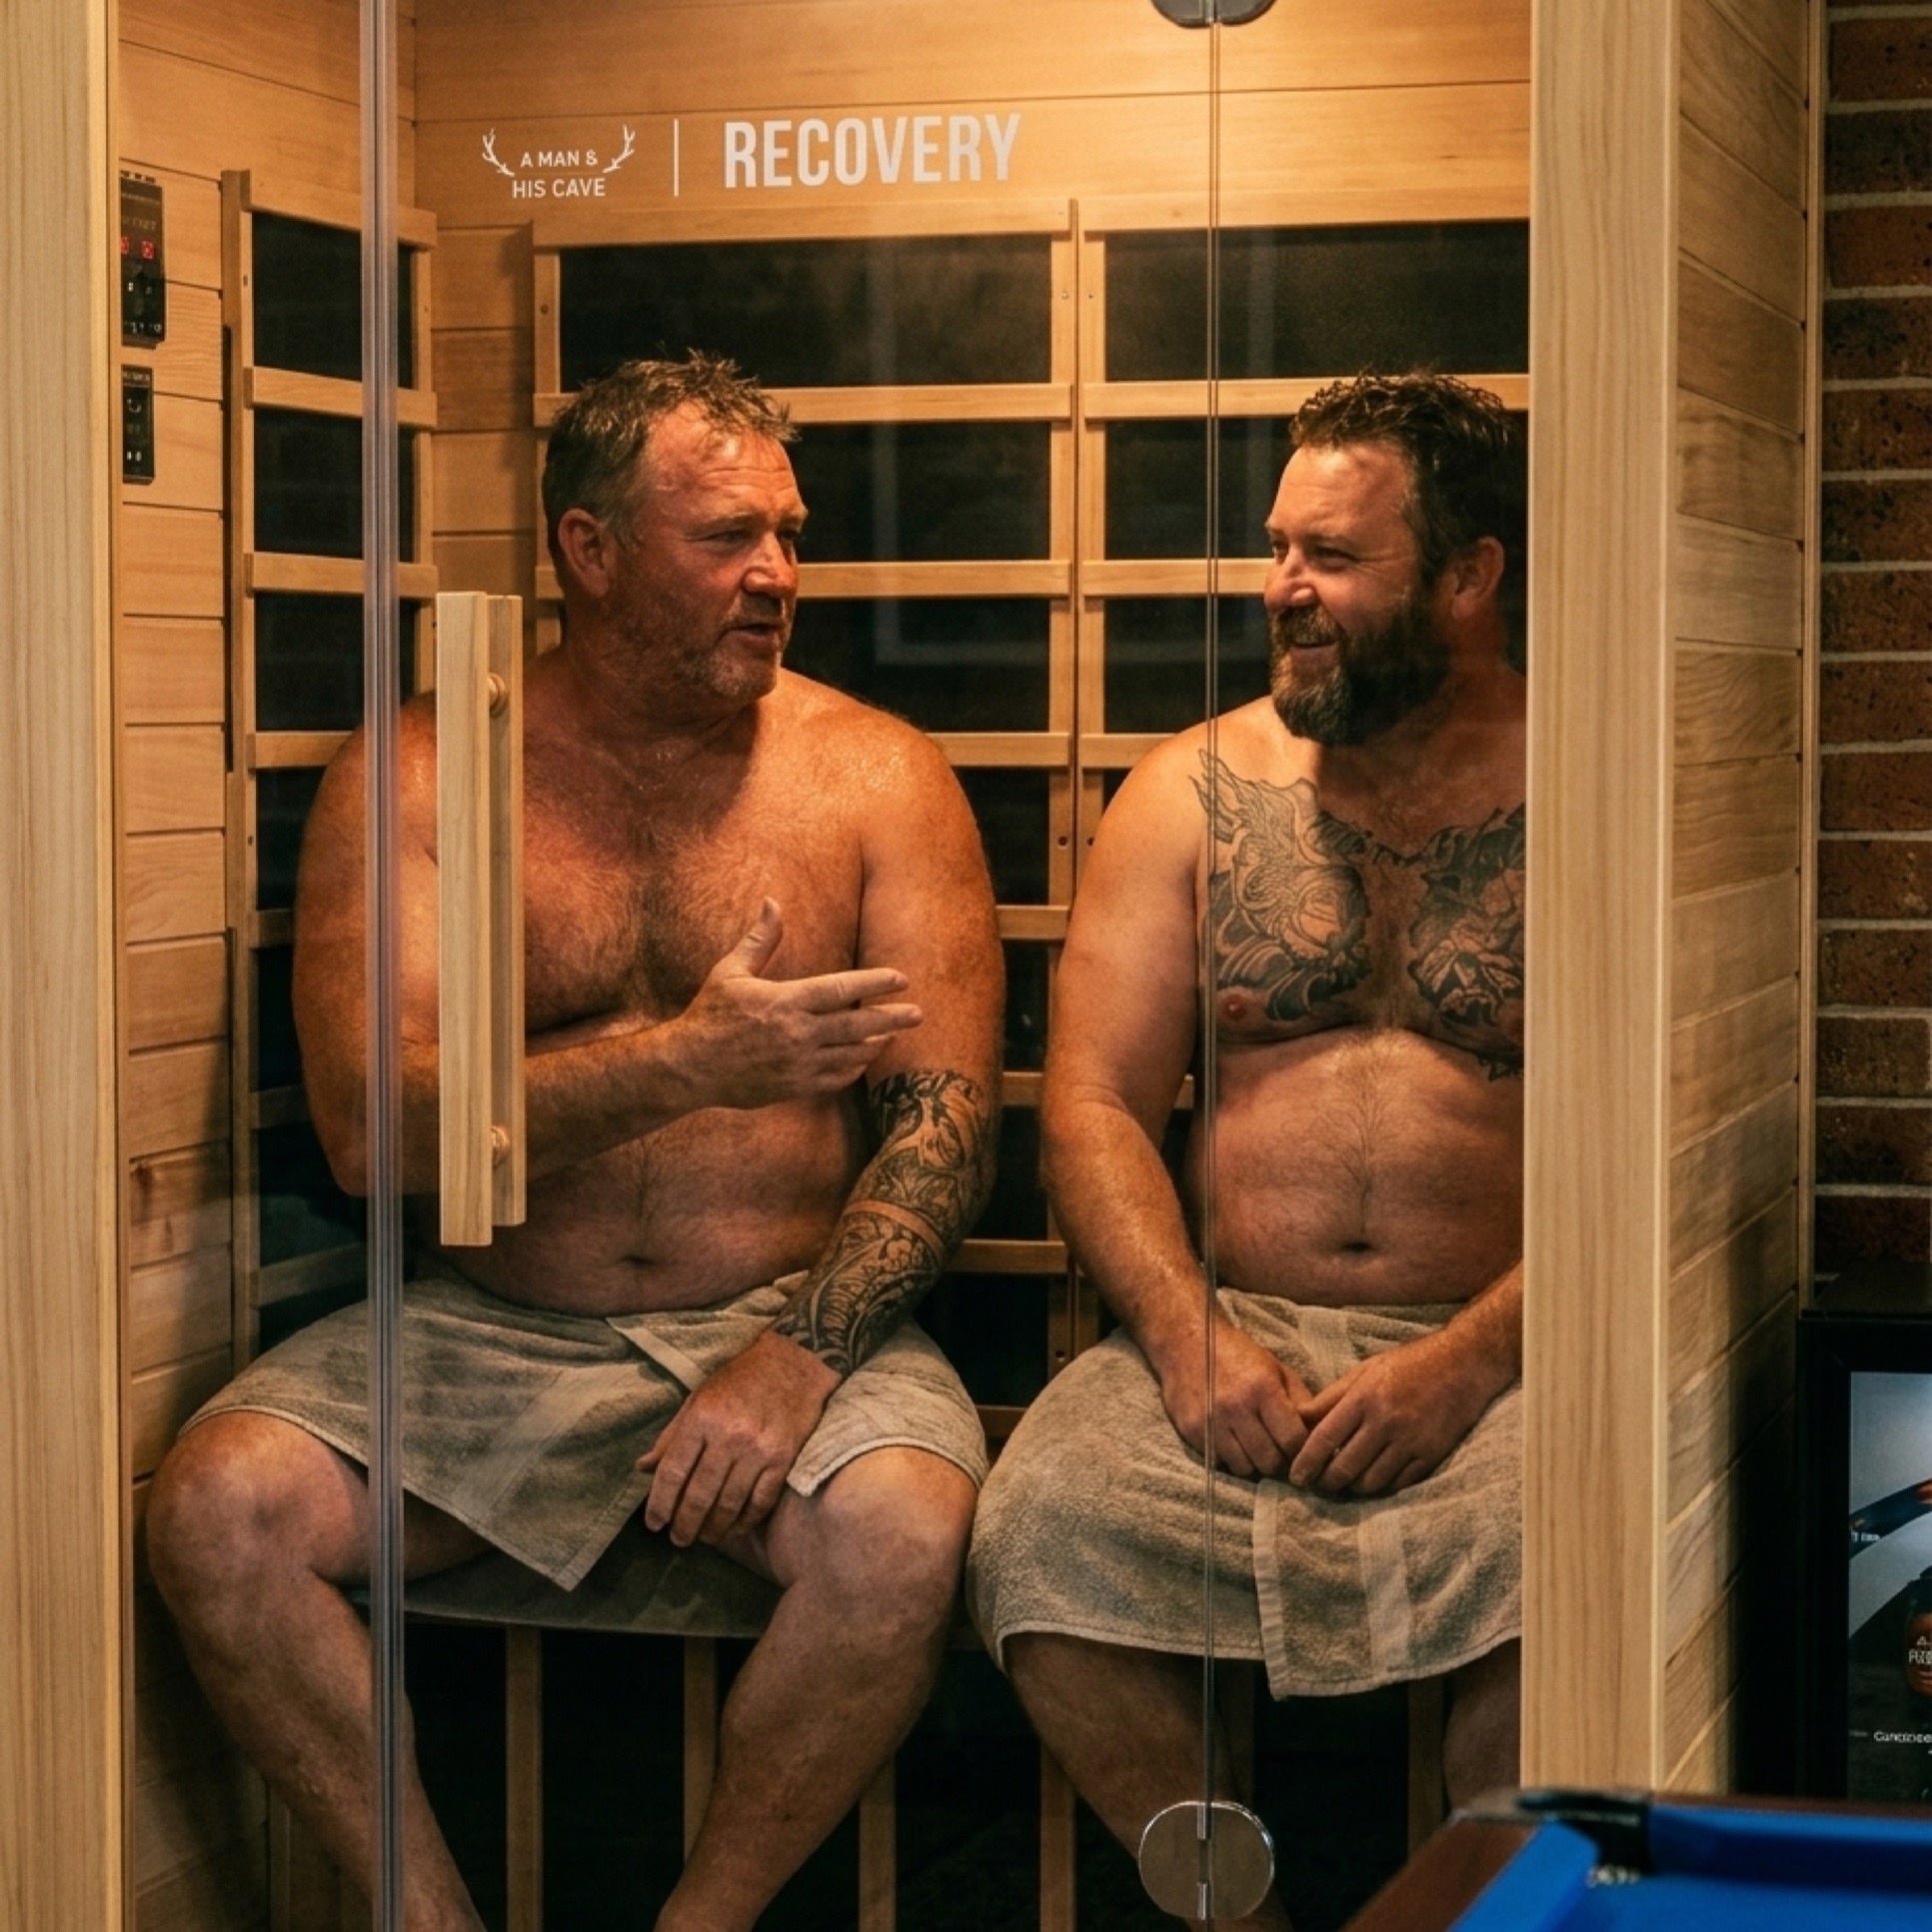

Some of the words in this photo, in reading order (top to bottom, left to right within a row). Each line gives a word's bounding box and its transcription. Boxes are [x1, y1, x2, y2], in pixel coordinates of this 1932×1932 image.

[521, 152, 533, 168] A
[539, 150, 580, 167] MAN
[586, 149, 599, 166] &
[725, 112, 1020, 188] RECOVERY
[512, 179, 546, 198] HIS
[552, 177, 606, 197] CAVE
